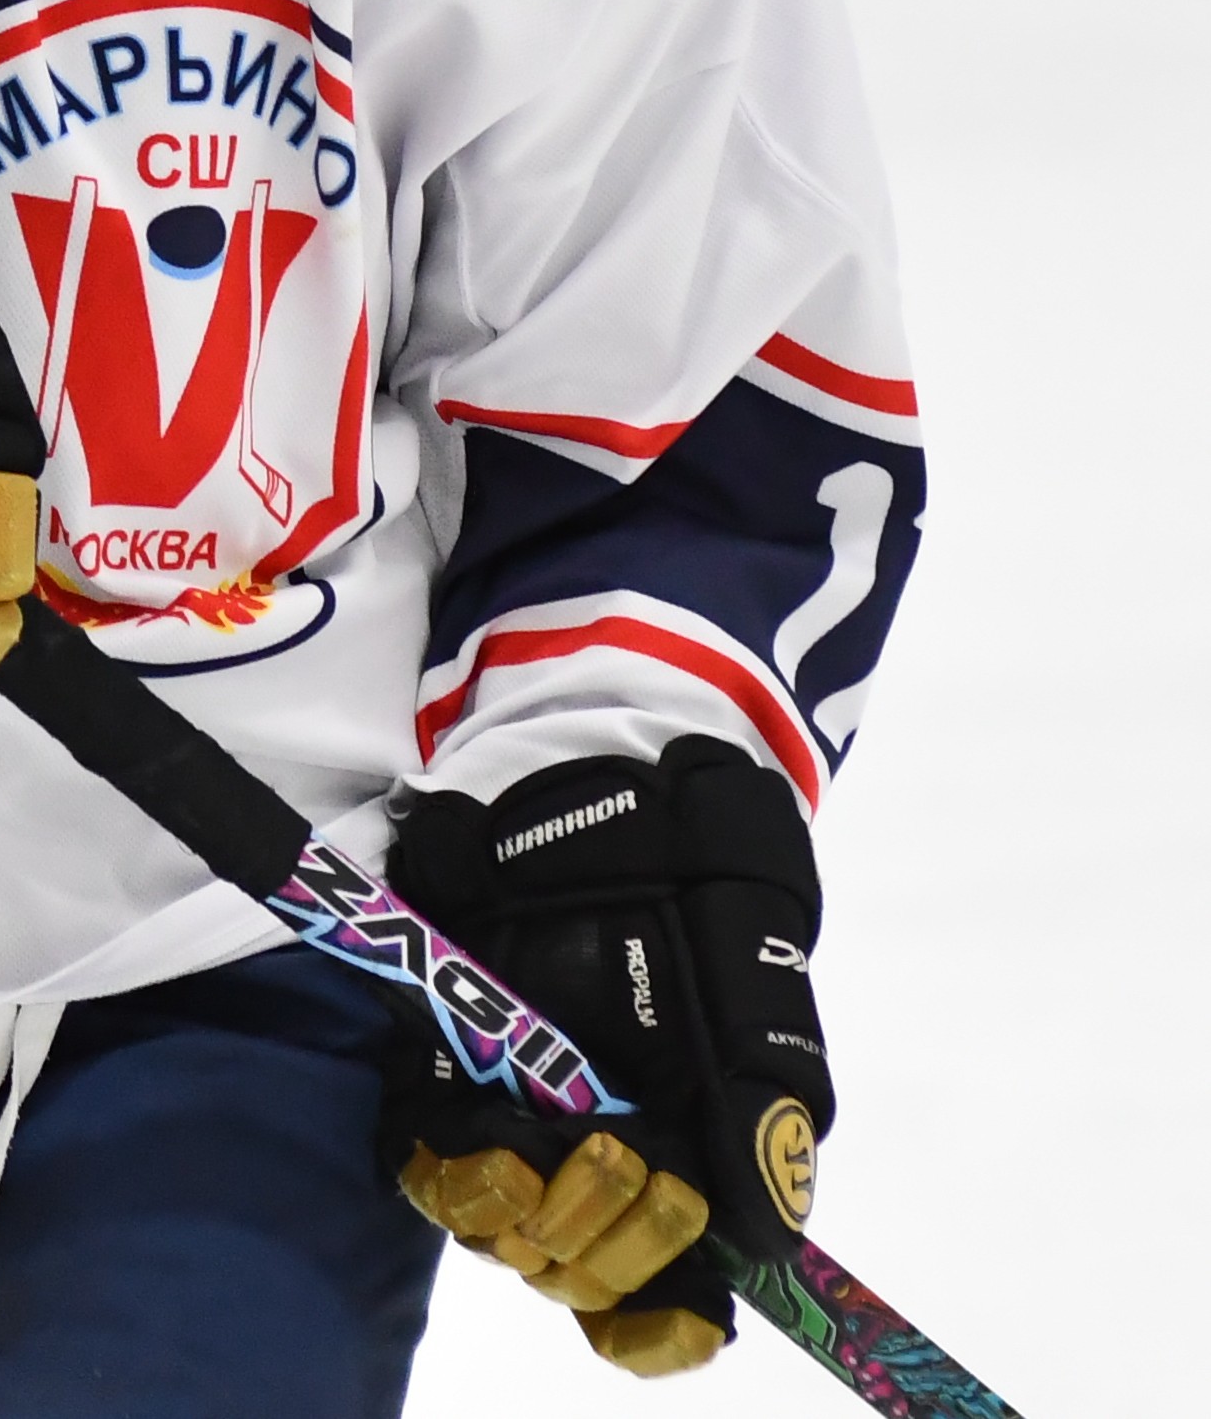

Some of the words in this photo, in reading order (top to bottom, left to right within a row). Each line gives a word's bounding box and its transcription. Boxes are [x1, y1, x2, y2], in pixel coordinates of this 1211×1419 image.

[136, 132, 239, 190] СШ
[774, 460, 927, 754] 1
[496, 789, 638, 864] WARRIOR
[624, 937, 659, 1029] PROPALM
